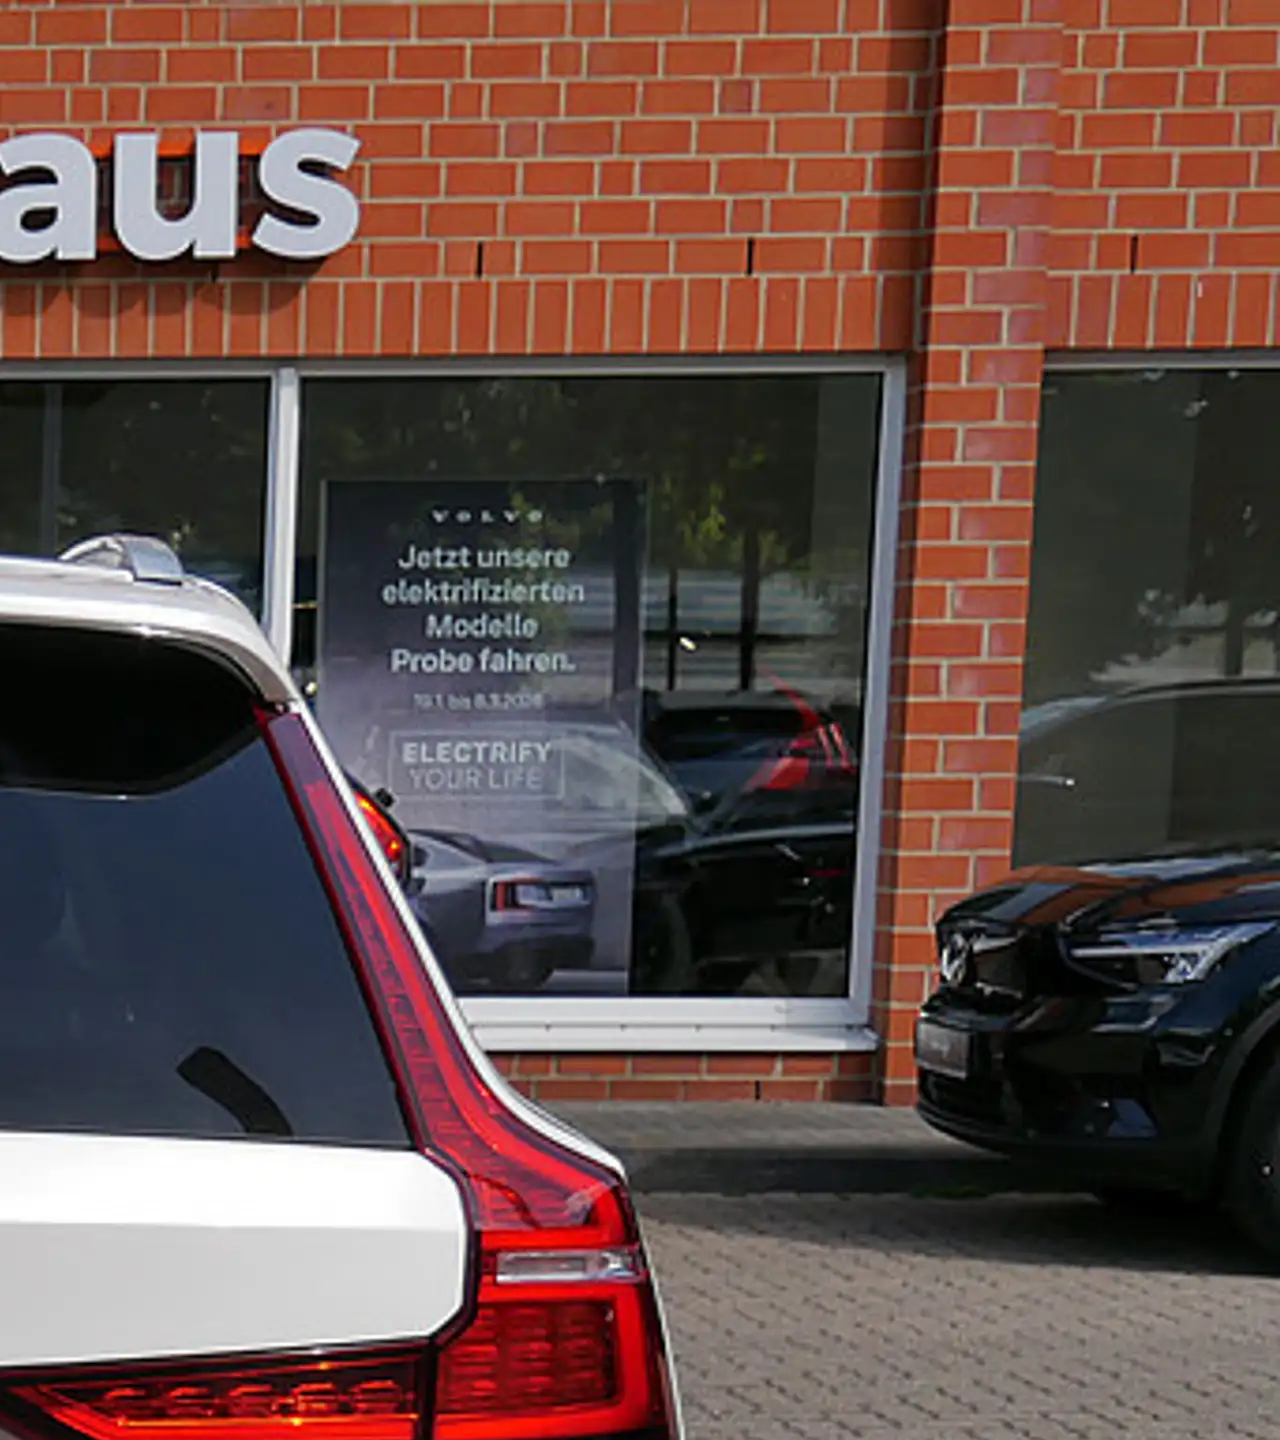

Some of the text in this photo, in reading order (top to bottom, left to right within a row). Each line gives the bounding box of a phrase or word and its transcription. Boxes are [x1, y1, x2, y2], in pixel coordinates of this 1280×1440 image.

[432, 509, 544, 524] VOLVO
[397, 545, 572, 569] Jetzt unsere
[381, 578, 586, 605] elektrifizierten
[425, 614, 539, 639] Modelle
[390, 647, 577, 674] Probe fahren.
[401, 740, 553, 764] ELECTRIFY
[408, 767, 544, 791] YOUR LIFE
